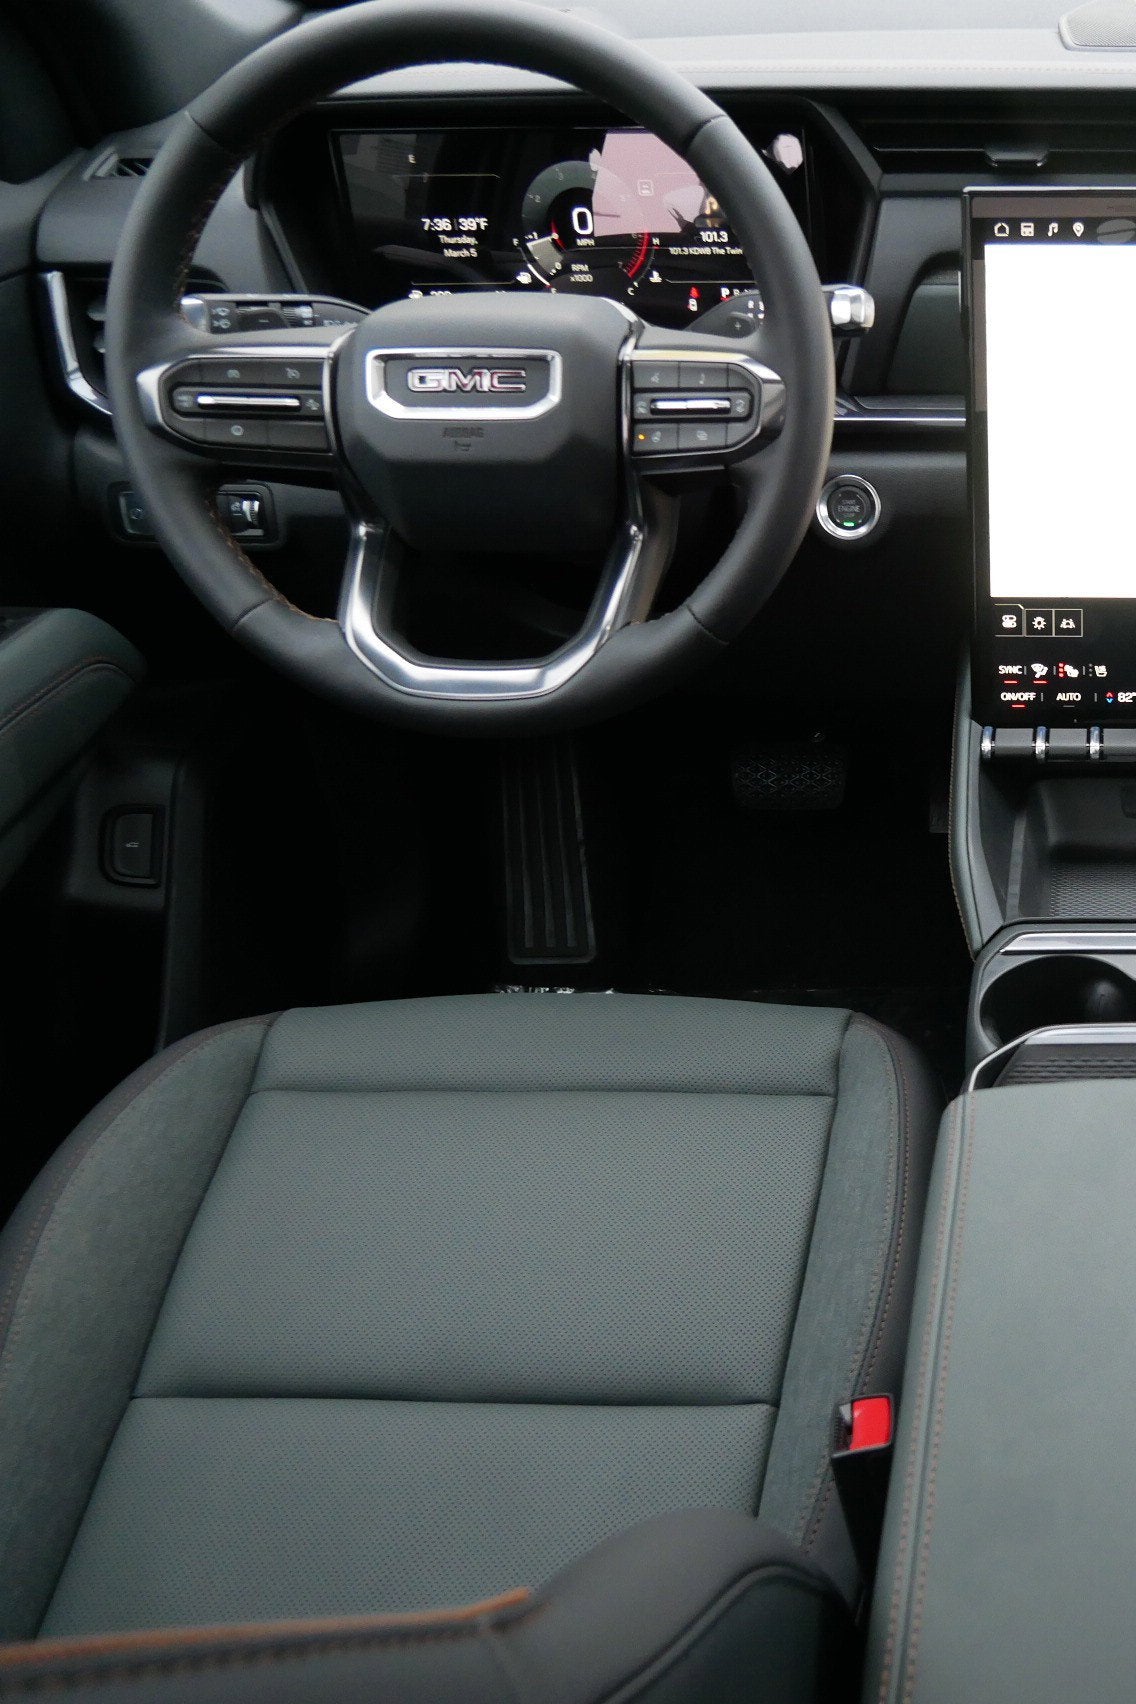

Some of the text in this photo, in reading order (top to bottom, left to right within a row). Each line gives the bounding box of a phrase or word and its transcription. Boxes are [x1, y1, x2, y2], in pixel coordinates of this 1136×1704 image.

[421, 217, 488, 231] 7:36 39°F
[571, 206, 594, 235] 0
[652, 237, 660, 246] H
[700, 230, 729, 243] 101.3
[577, 238, 595, 247] MPH
[443, 248, 478, 258] March 5
[668, 246, 689, 255] 101.3
[711, 246, 726, 255] The
[571, 263, 589, 272] RPM
[569, 273, 594, 283] x1000
[407, 367, 527, 393] GMC
[998, 664, 1023, 675] SYNC
[1000, 692, 1037, 702] ON/OFF
[1056, 692, 1082, 702] AUTO
[1117, 691, 1136, 703] 82°
